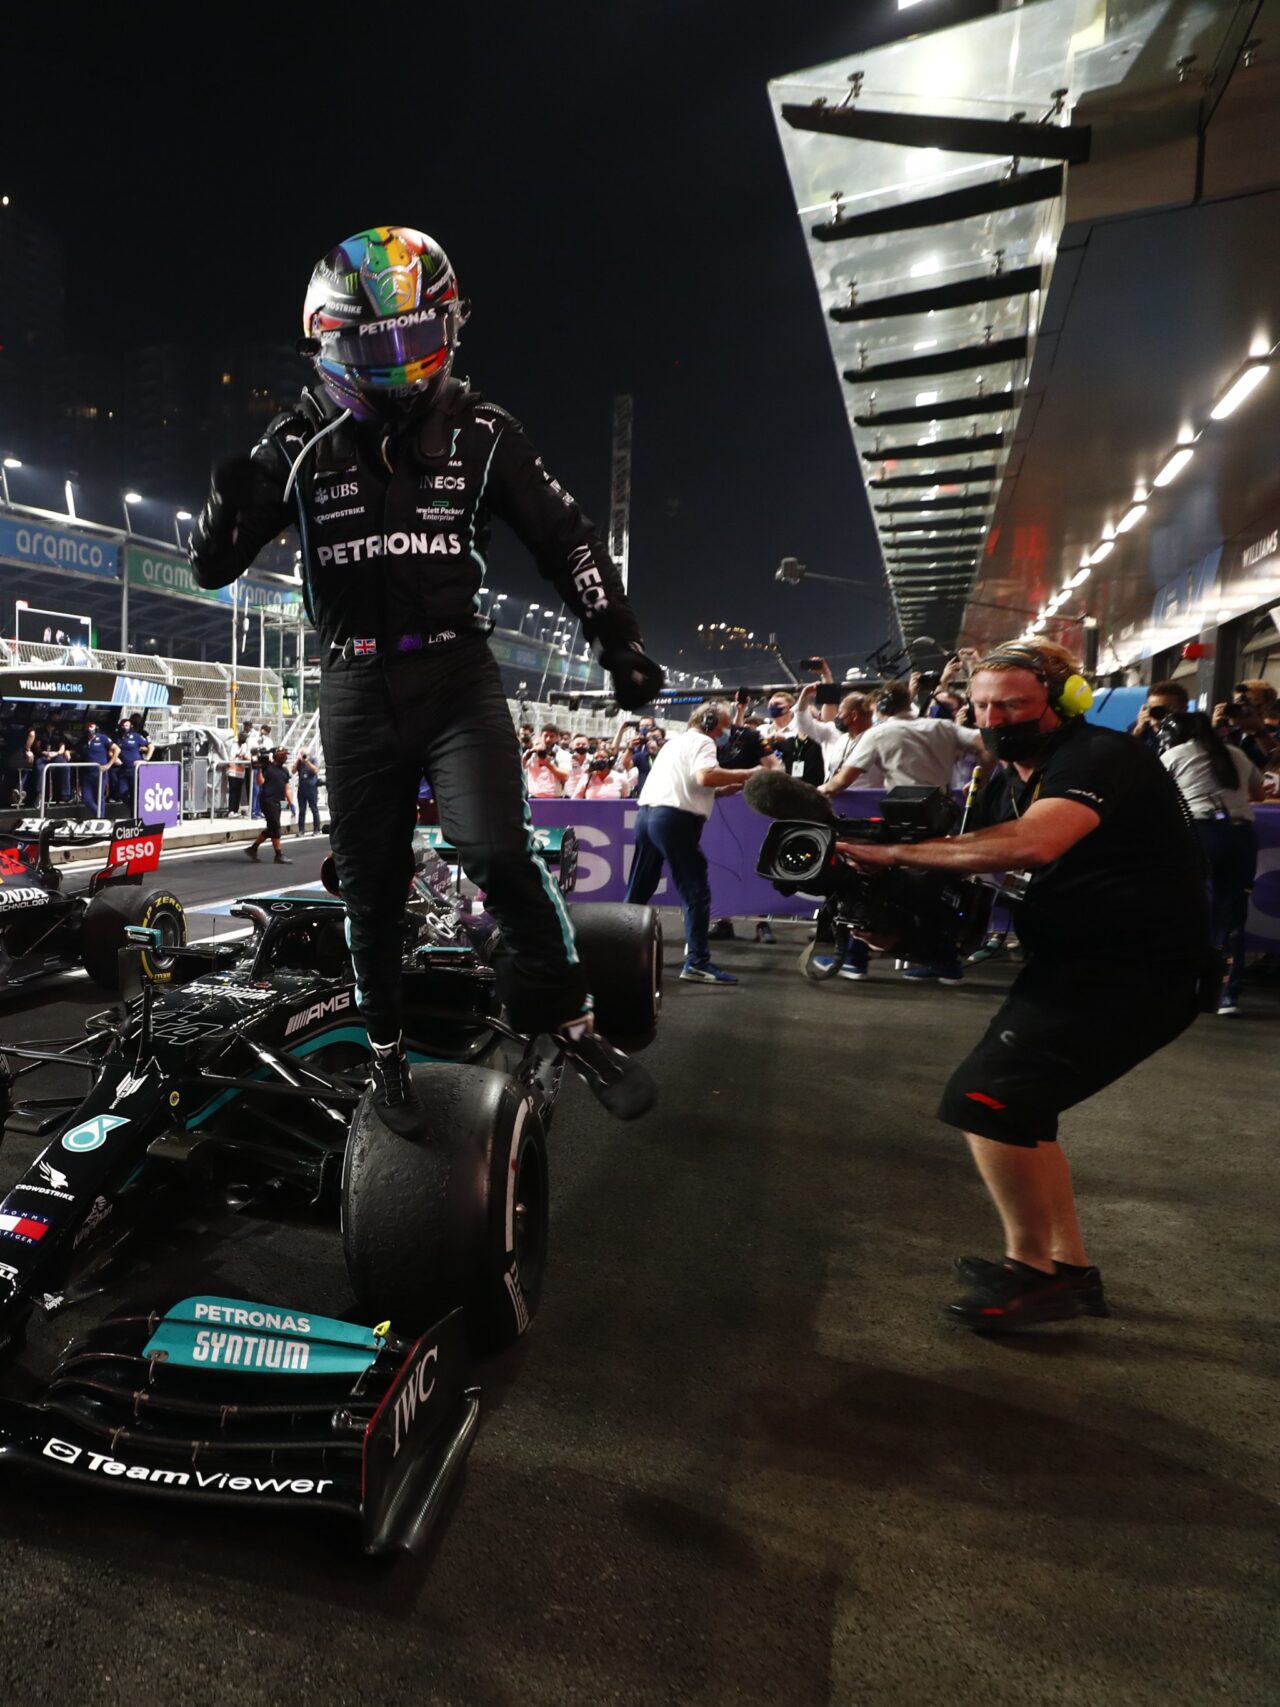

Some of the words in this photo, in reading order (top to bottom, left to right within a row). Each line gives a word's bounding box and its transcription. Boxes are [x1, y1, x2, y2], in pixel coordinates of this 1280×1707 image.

[359, 308, 437, 336] PETRONAS
[330, 482, 359, 499] UBS
[420, 476, 466, 490] INEOS
[317, 506, 365, 522] CROWDSTRIKE
[416, 506, 439, 515] ewlett
[422, 513, 455, 522] Enterprise
[16, 528, 102, 568] aramco
[317, 531, 461, 567] PETRONAS
[1243, 528, 1278, 568] WILLIAMS
[142, 558, 207, 592] aramc
[19, 680, 56, 692] WILLIAMS
[56, 682, 83, 693] RACING
[144, 782, 174, 812] stc
[116, 841, 154, 862] ESSO
[154, 896, 182, 912] ZERO
[307, 991, 351, 1021] AMG
[15, 1184, 75, 1202] CROWDSTRIKE
[3, 1208, 48, 1223] TOMMY
[195, 1303, 311, 1333] PETRONAS
[192, 1330, 311, 1370] SYNTIUM
[393, 1345, 438, 1458] IWC
[86, 1451, 334, 1495] TeamViewer
